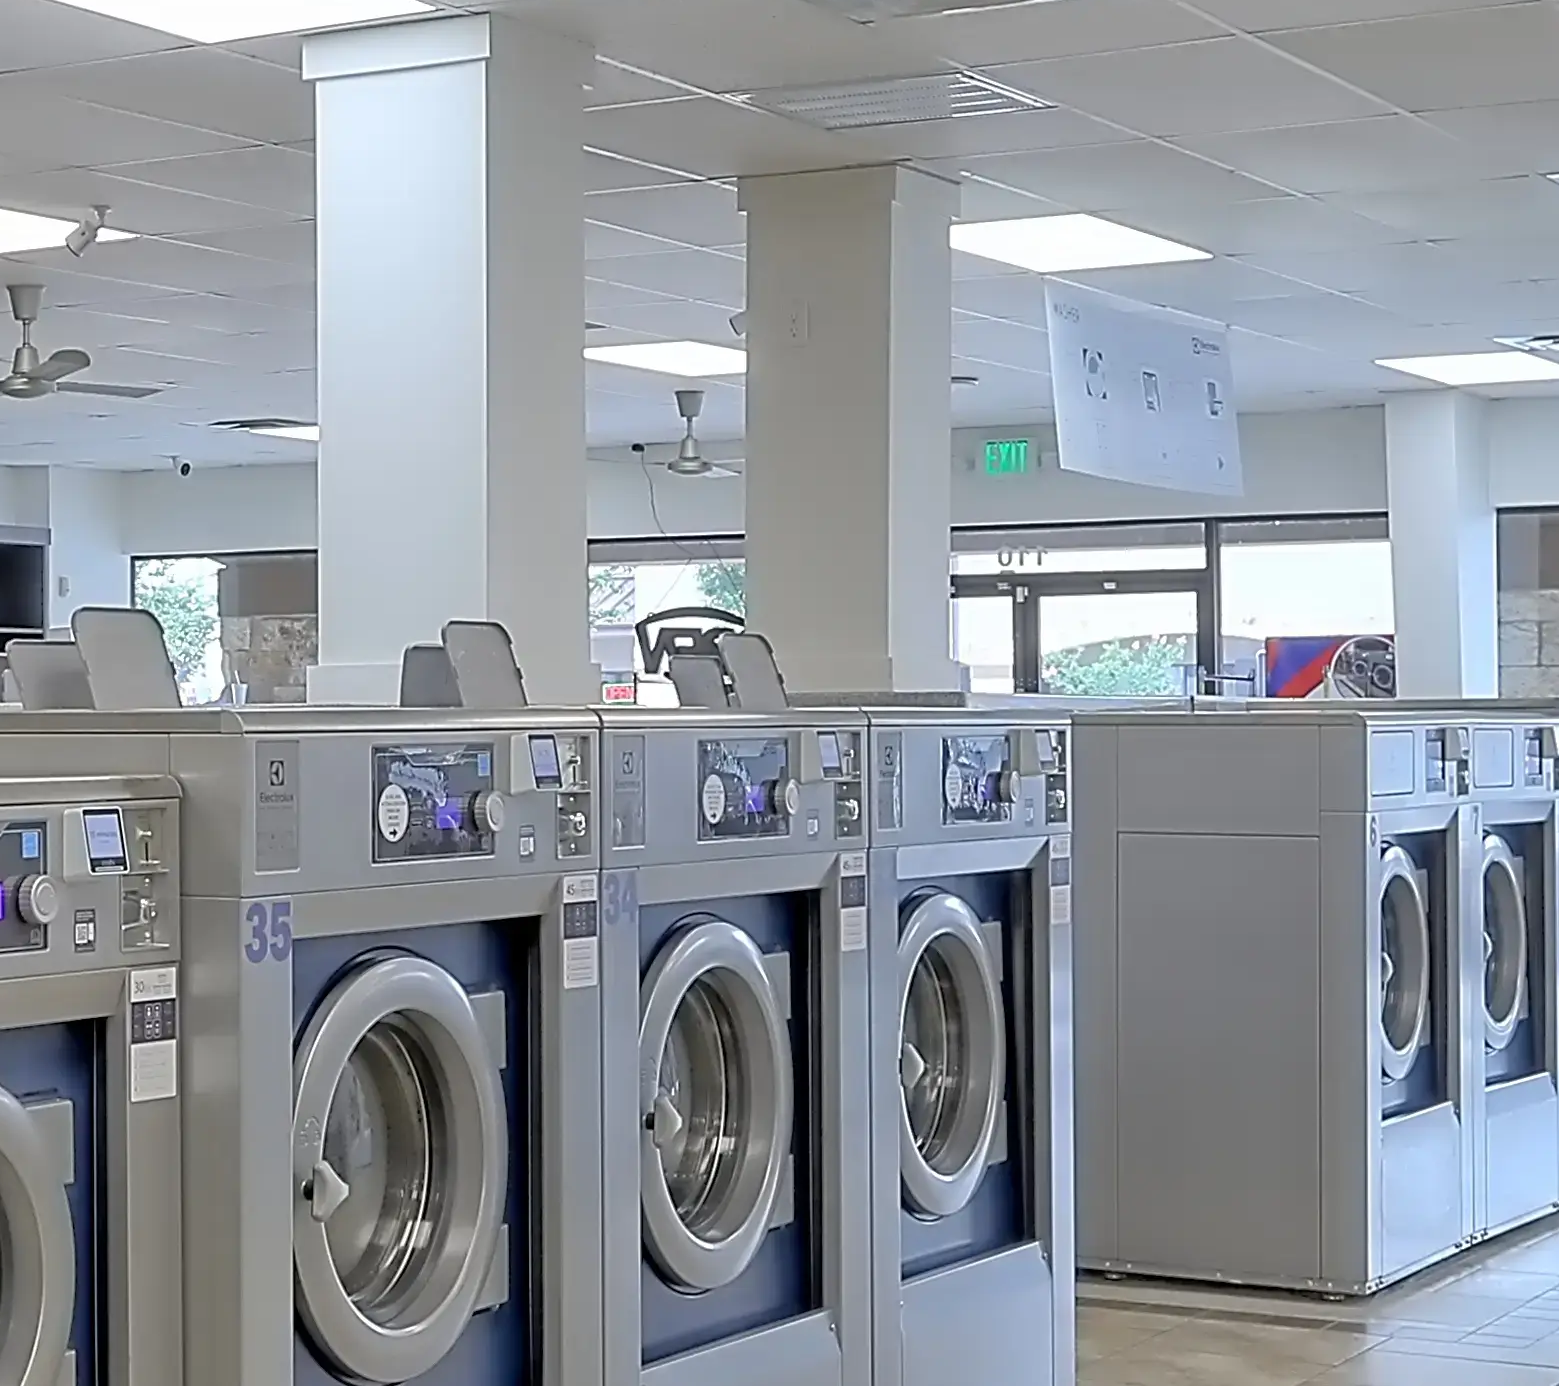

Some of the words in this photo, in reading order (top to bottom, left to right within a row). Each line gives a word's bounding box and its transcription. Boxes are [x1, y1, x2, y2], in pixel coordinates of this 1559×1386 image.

[985, 440, 1028, 475] EXIT
[1369, 814, 1378, 848] 6
[603, 873, 639, 926] 34
[243, 901, 292, 964] 35
